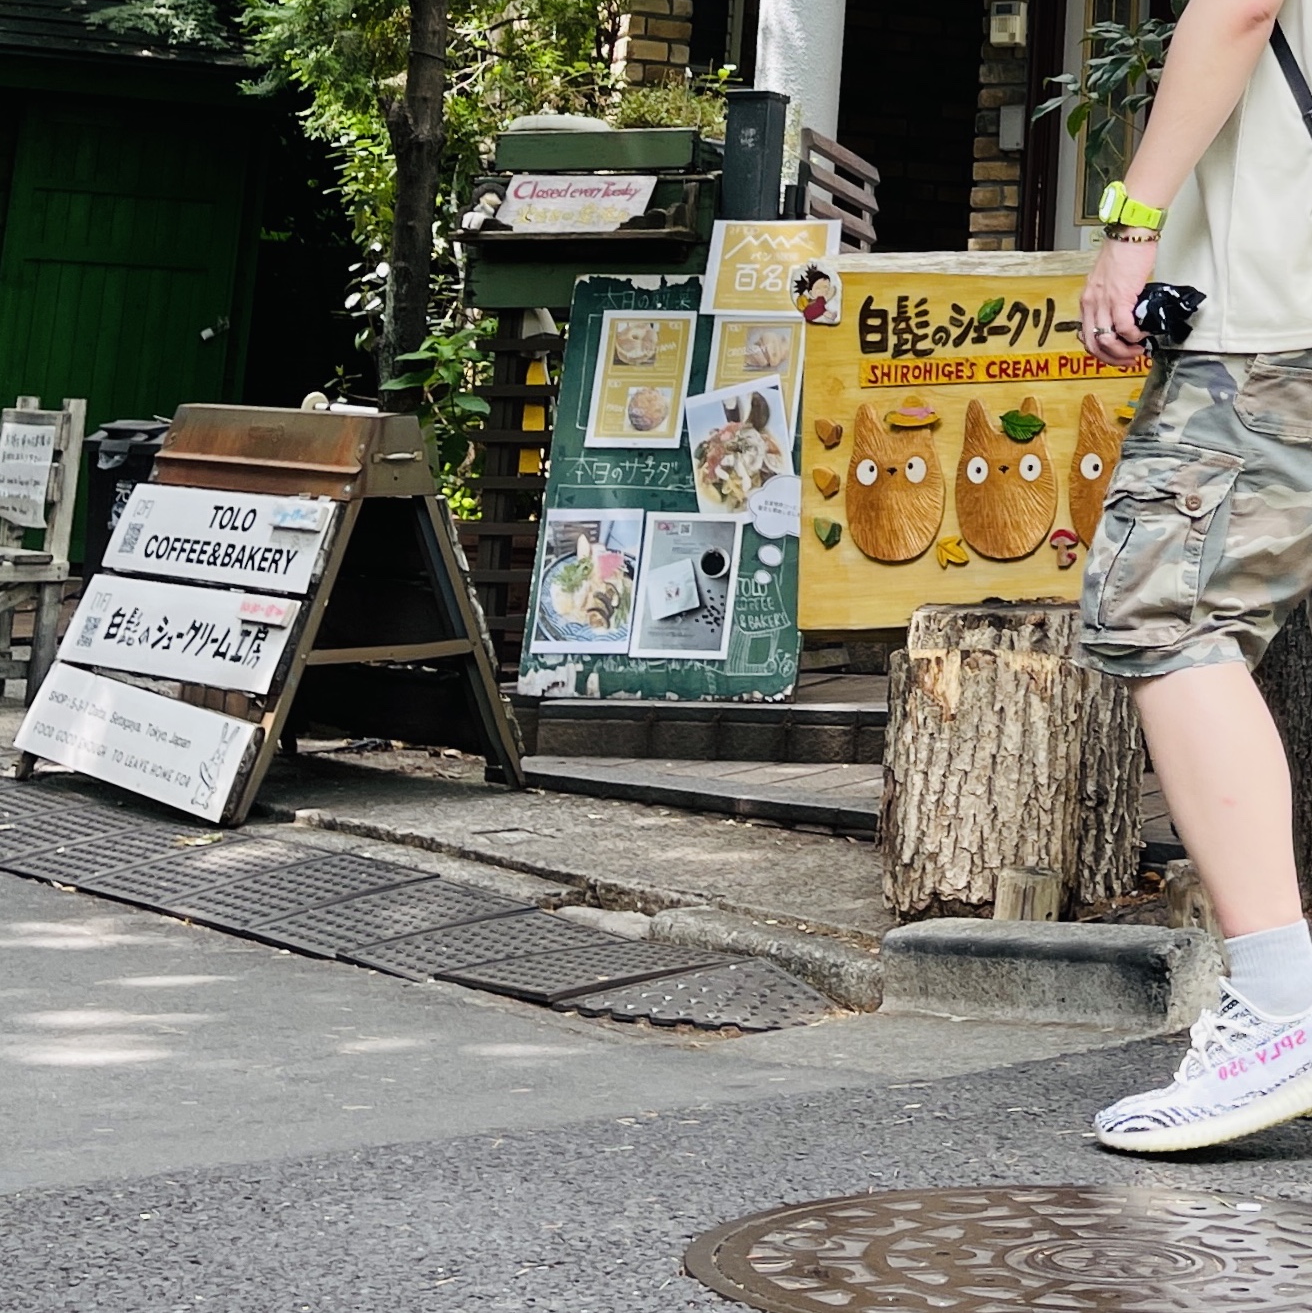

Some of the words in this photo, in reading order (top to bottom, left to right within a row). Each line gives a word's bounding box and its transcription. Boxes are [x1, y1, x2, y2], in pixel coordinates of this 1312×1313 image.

[513, 180, 572, 200] Closed
[735, 263, 796, 292] 百名
[867, 358, 978, 385] SHIROHIGE'S
[985, 358, 1050, 379] CREAM
[563, 450, 679, 485] 本日のサラダ
[209, 505, 257, 532] TOLO
[144, 535, 299, 575] COFFEE&BAKERY
